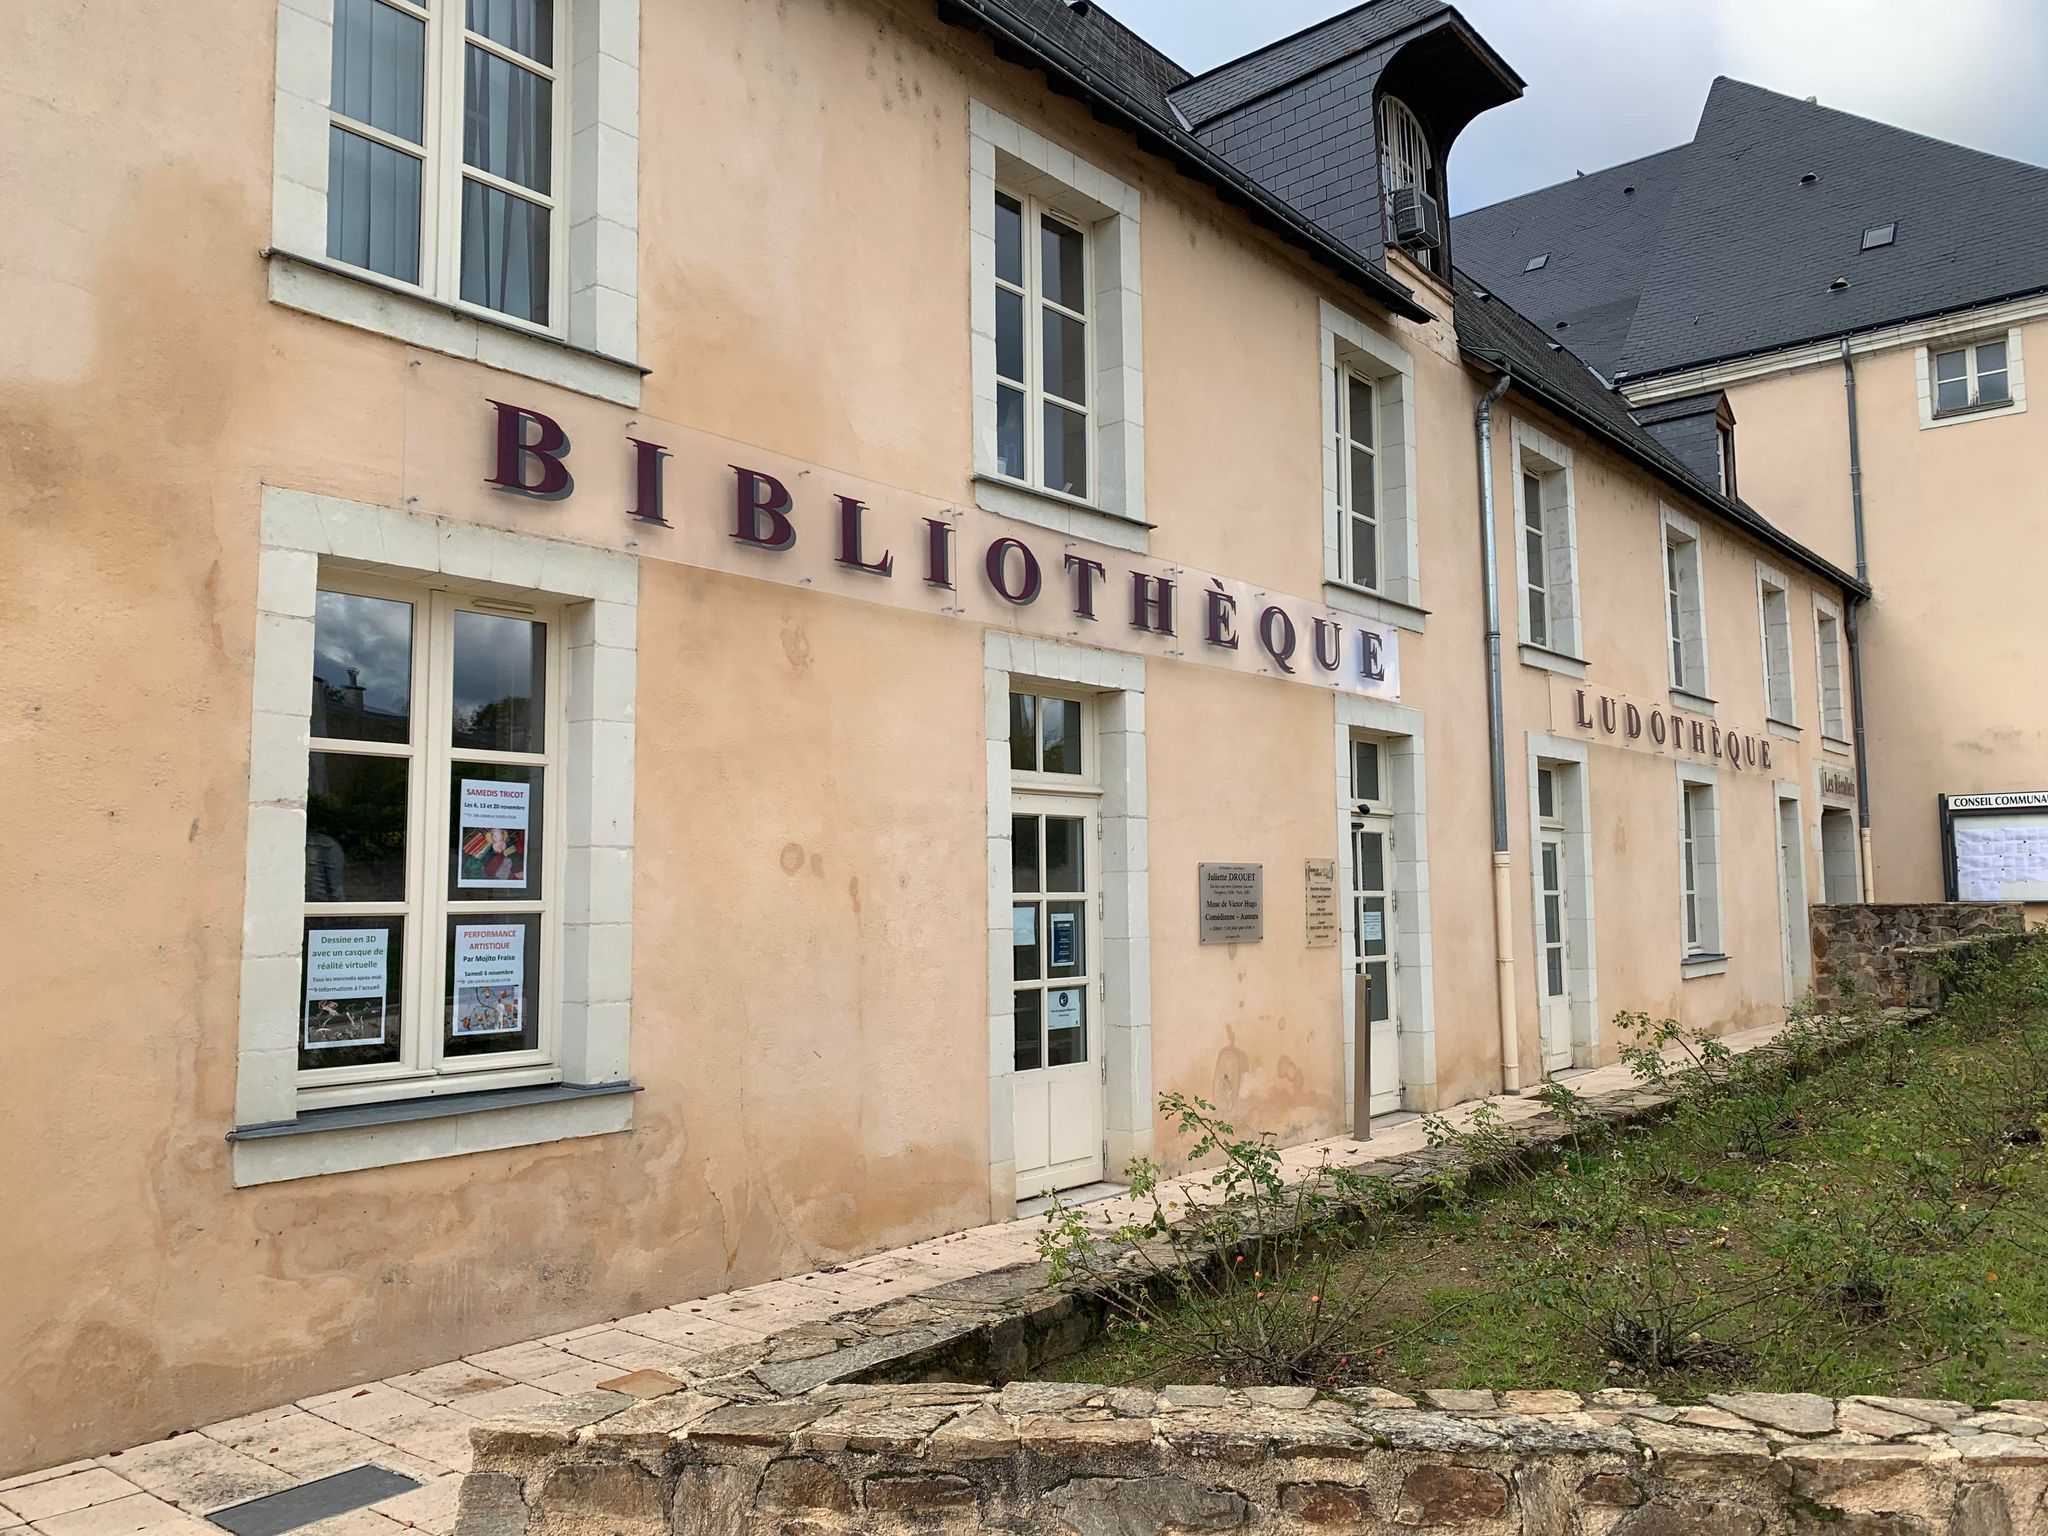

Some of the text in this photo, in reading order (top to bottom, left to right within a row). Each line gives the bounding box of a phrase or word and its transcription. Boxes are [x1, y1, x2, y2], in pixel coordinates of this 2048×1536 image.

[485, 399, 1386, 681] BIBLIOTHÈQUE
[1576, 689, 1772, 771] LUDOTHÈQUE
[1824, 771, 1834, 793] Les
[466, 788, 524, 798] SAMEDIS TRICOT
[1954, 794, 2048, 807] CONSEIL COMMUNA
[1207, 872, 1256, 882] Juliette DROUET
[1206, 899, 1258, 909] Muse de Victor Hugo
[1205, 913, 1235, 921] Comédienne
[463, 930, 517, 938] PERFORMANCE
[321, 936, 352, 944] Dessine
[365, 935, 377, 943] 3D
[469, 942, 510, 950] ARTISTIQUE
[345, 949, 372, 957] casque
[373, 948, 384, 956] de
[475, 955, 496, 963] Mojito
[317, 960, 378, 970] réalité virtuelle
